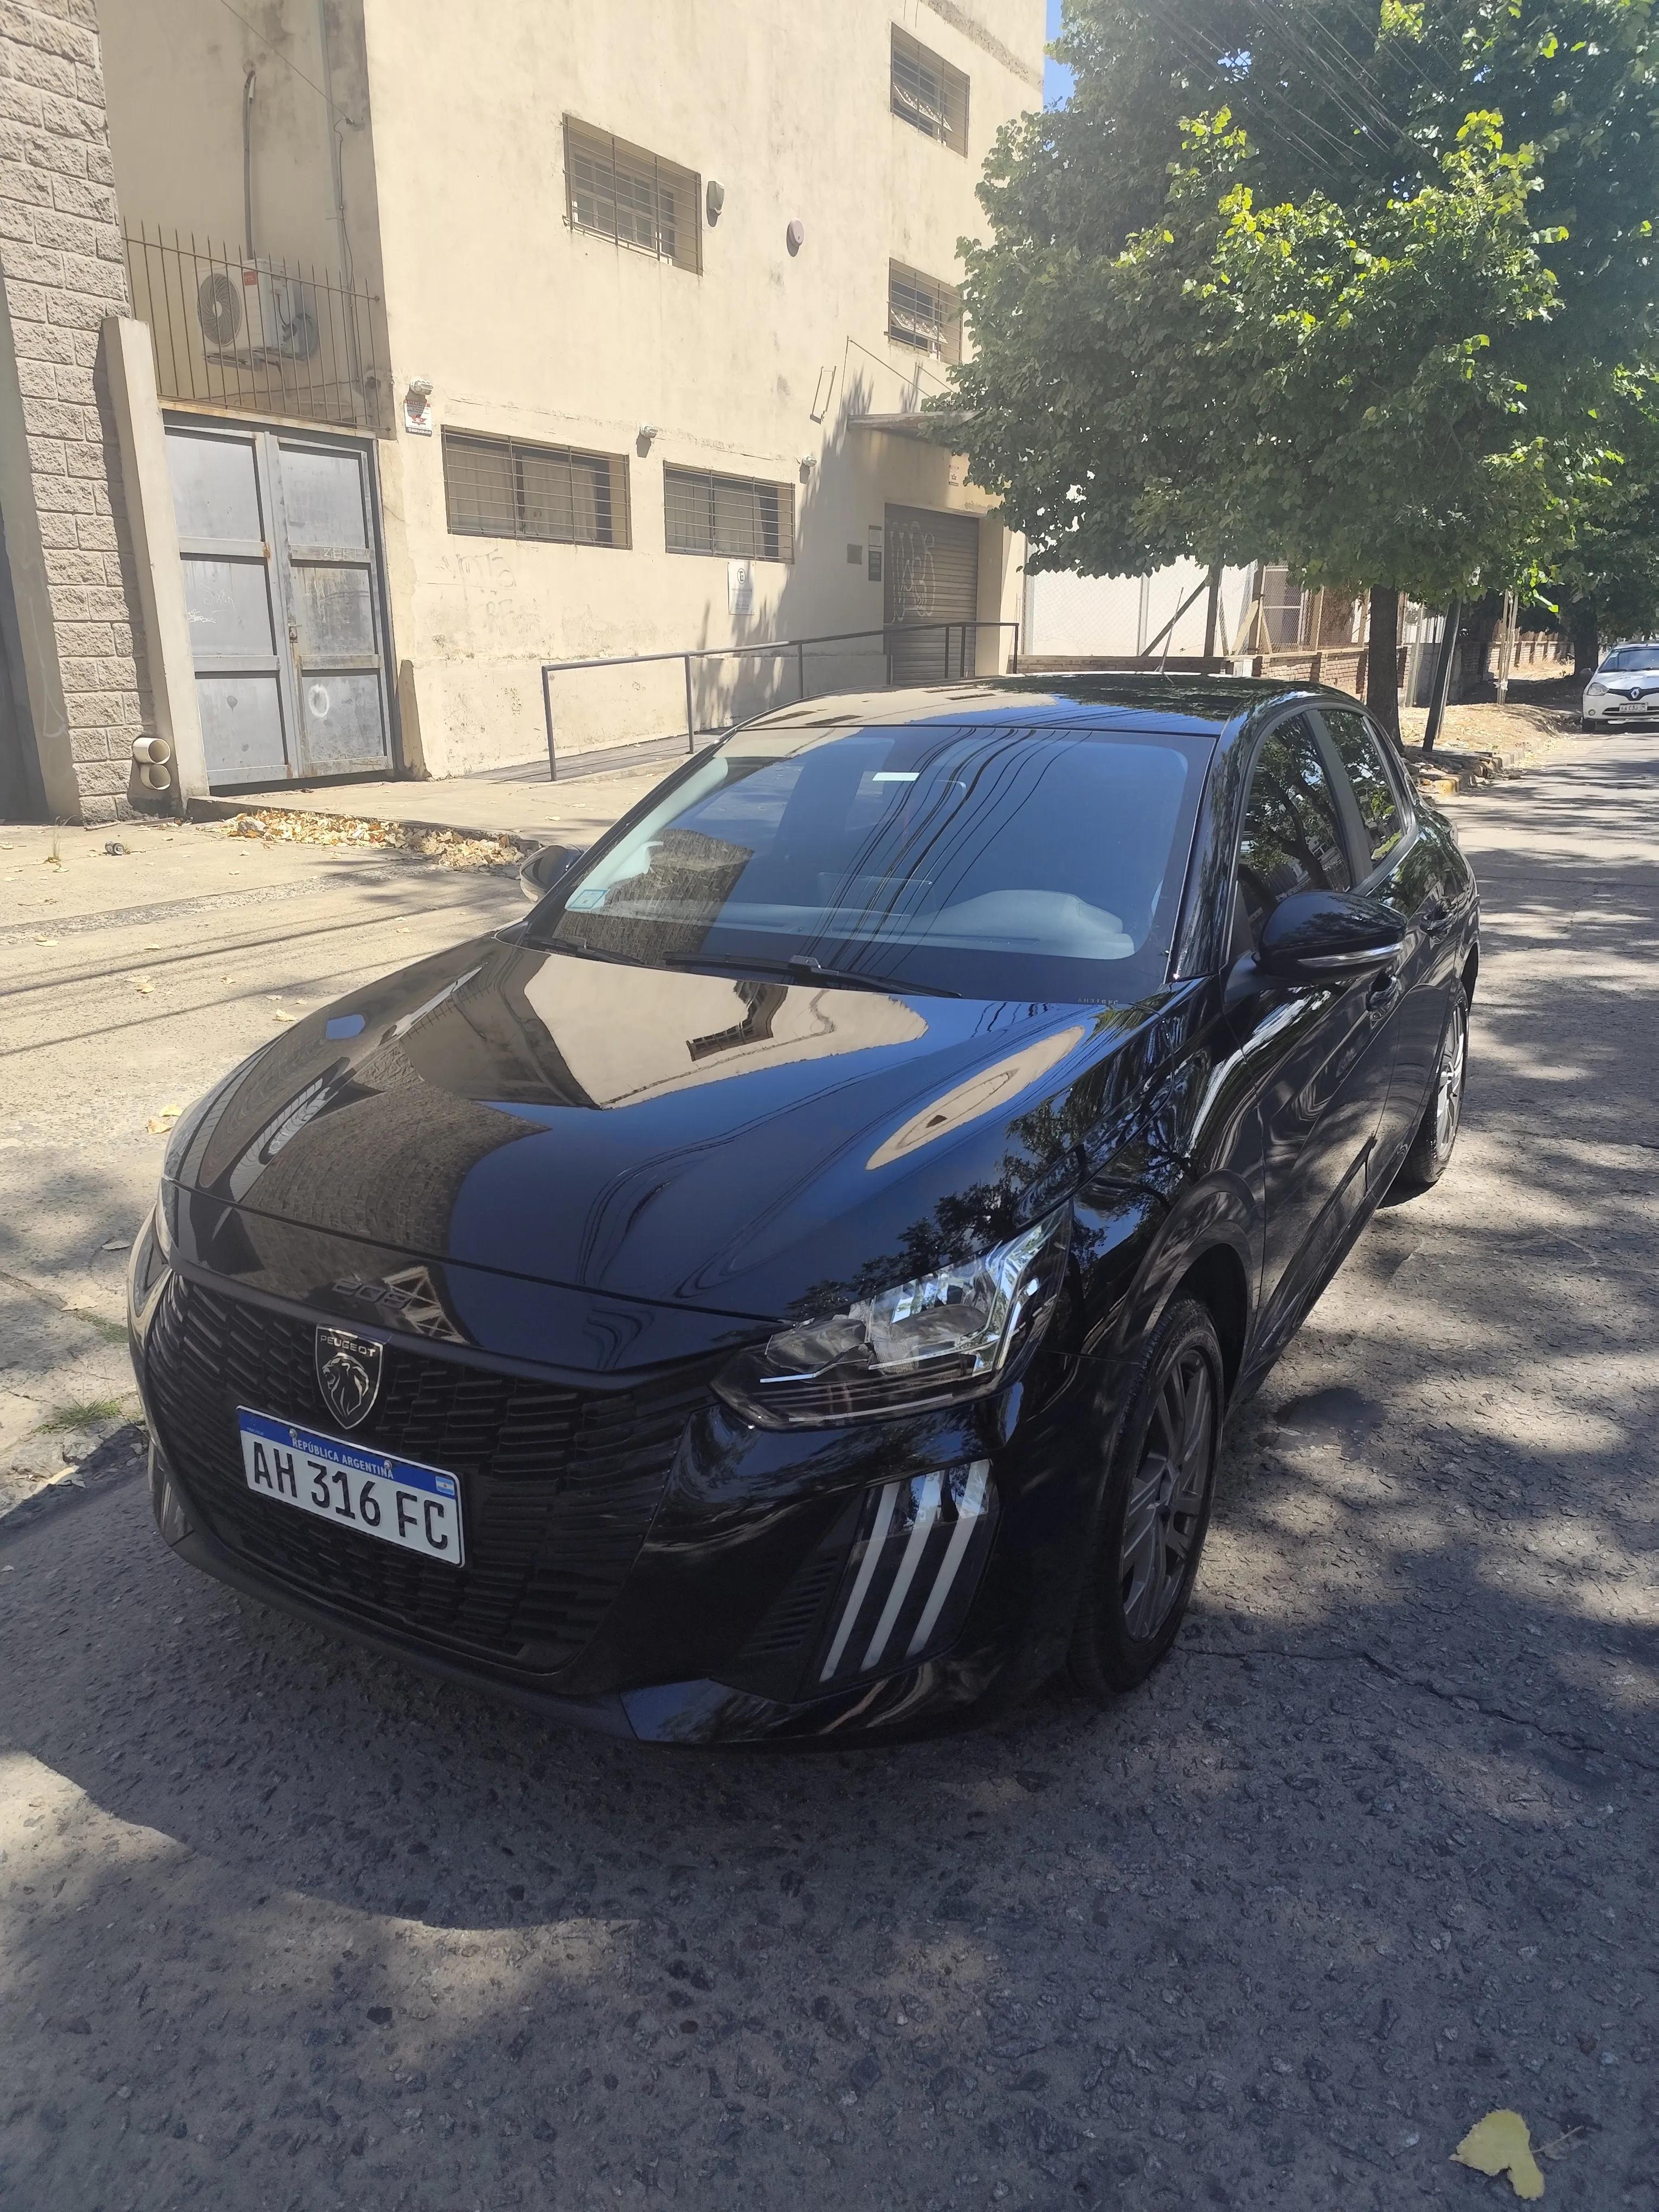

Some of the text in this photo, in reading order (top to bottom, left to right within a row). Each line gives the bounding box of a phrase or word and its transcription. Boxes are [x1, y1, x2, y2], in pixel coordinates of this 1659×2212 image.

[332, 1275, 413, 1310] 208
[320, 1335, 376, 1357] PEUGEOT
[292, 1438, 394, 1480] REPÚBLICA ARGENTINA
[254, 1441, 448, 1550] AH 316 FC
